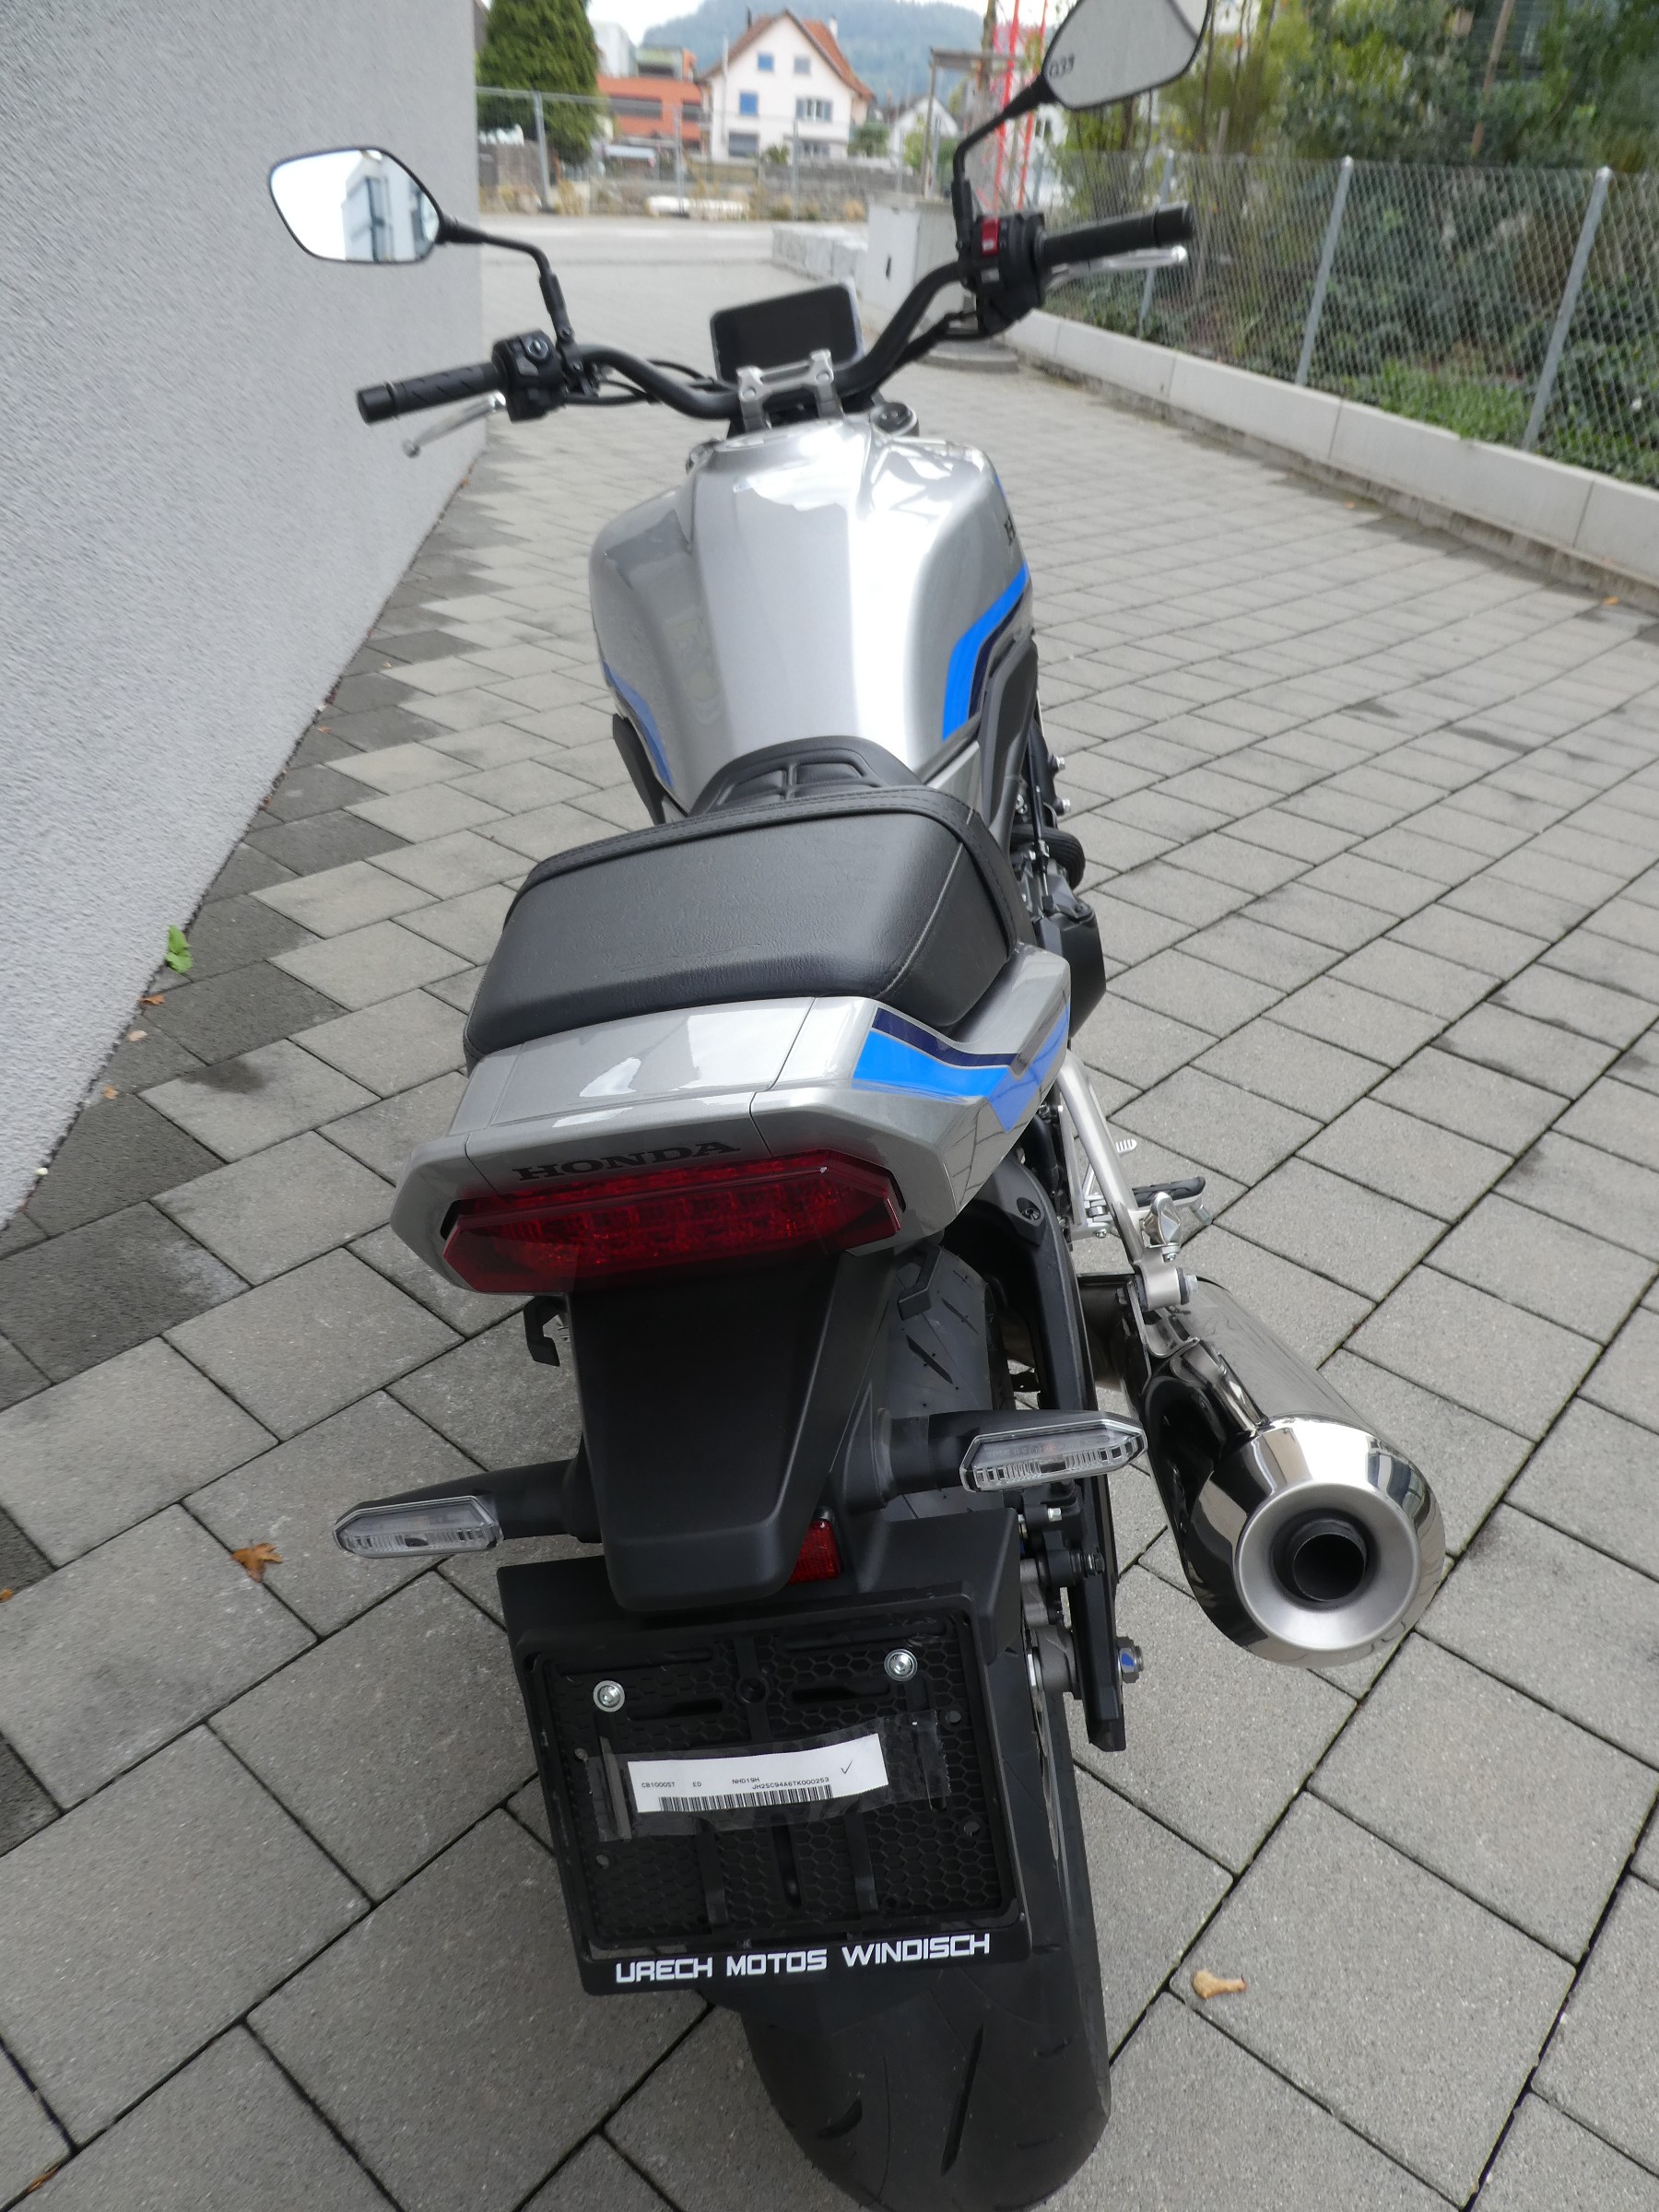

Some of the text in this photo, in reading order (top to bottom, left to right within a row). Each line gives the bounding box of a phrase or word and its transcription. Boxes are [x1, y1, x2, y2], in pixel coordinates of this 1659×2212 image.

[512, 1141, 740, 1181] HONDA
[615, 1934, 991, 1983] URECH MOTOS WINDISCH
